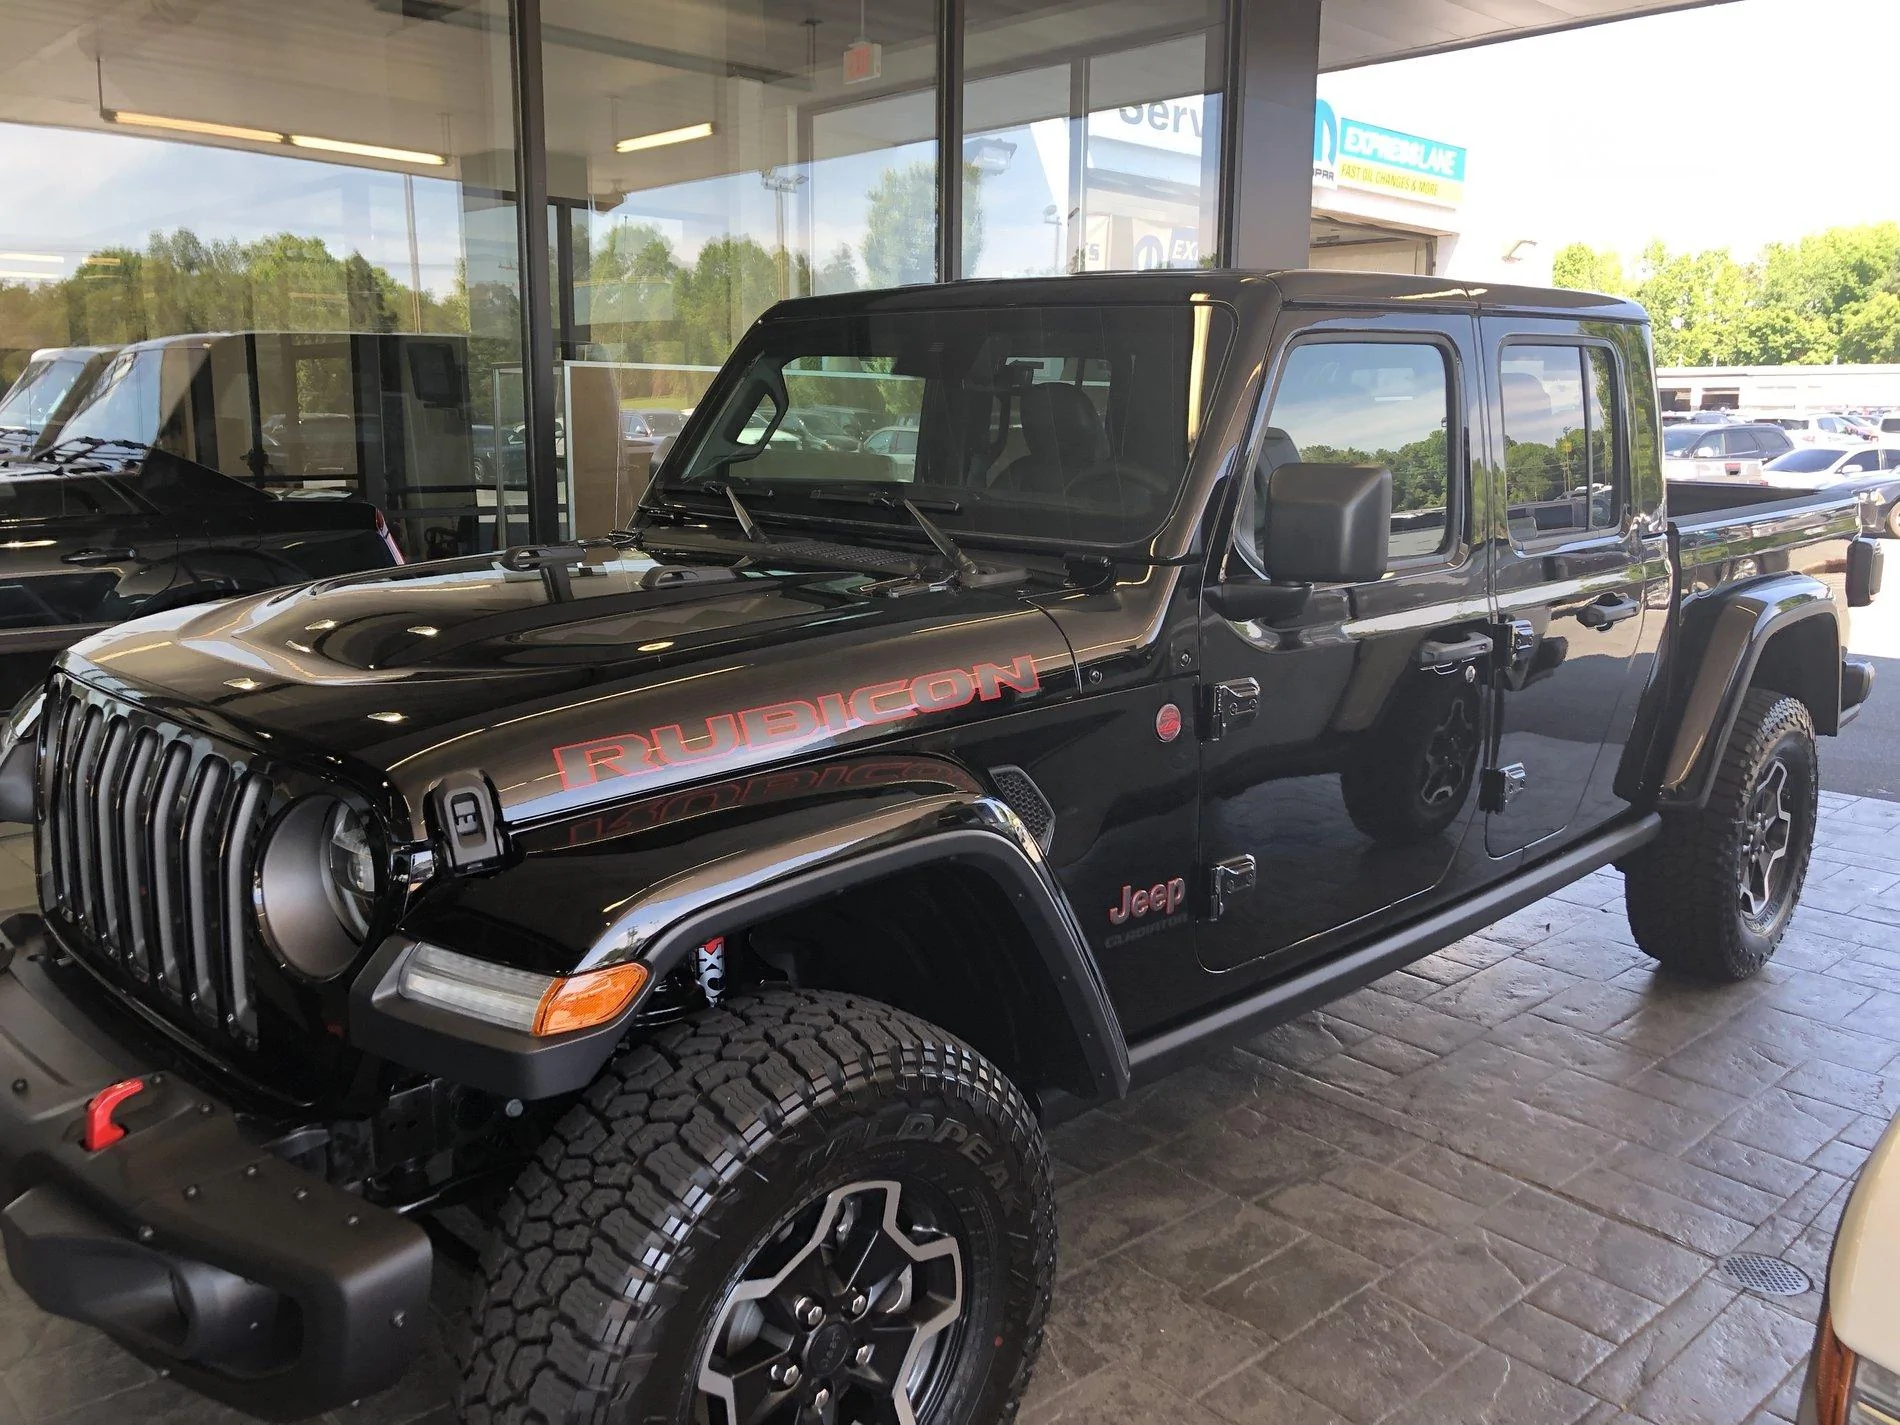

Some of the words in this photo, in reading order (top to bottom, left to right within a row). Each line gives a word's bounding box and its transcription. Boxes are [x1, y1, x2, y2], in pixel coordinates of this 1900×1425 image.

[1341, 163, 1362, 179] FAST
[1362, 167, 1374, 182] OIL
[1375, 170, 1410, 190] CHANGES
[1419, 182, 1439, 197] MORE
[552, 654, 1041, 790] RUBICON
[1109, 878, 1186, 925] Jeep
